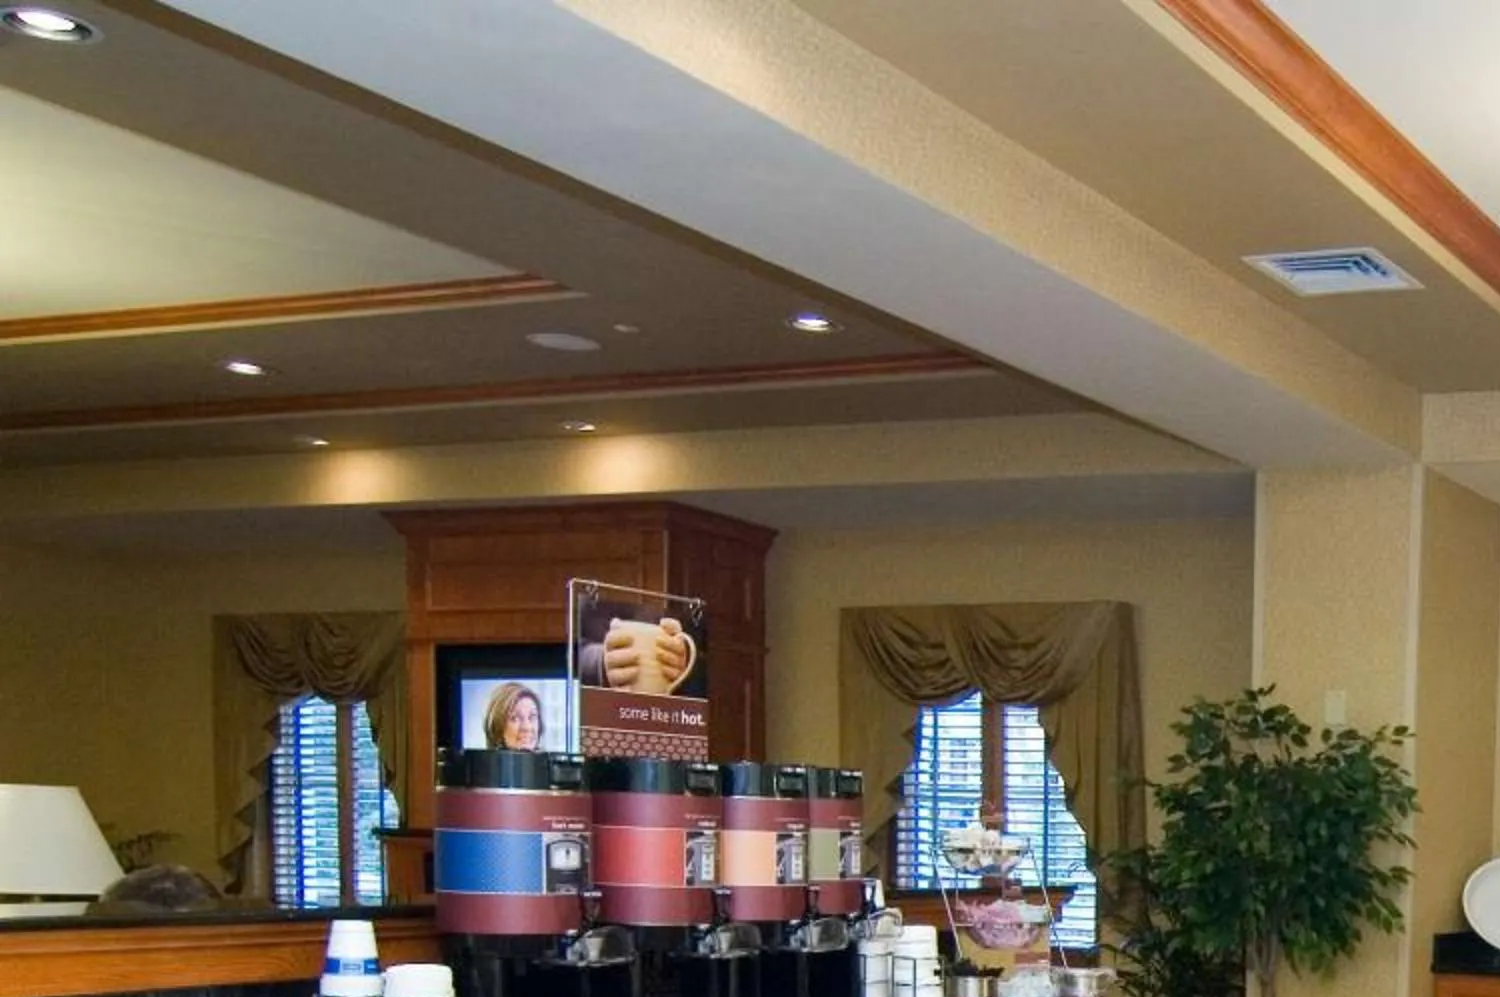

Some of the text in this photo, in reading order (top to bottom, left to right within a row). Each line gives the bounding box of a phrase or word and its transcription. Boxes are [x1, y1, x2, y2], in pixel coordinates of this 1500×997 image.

[619, 707, 706, 726] some like it hot.
